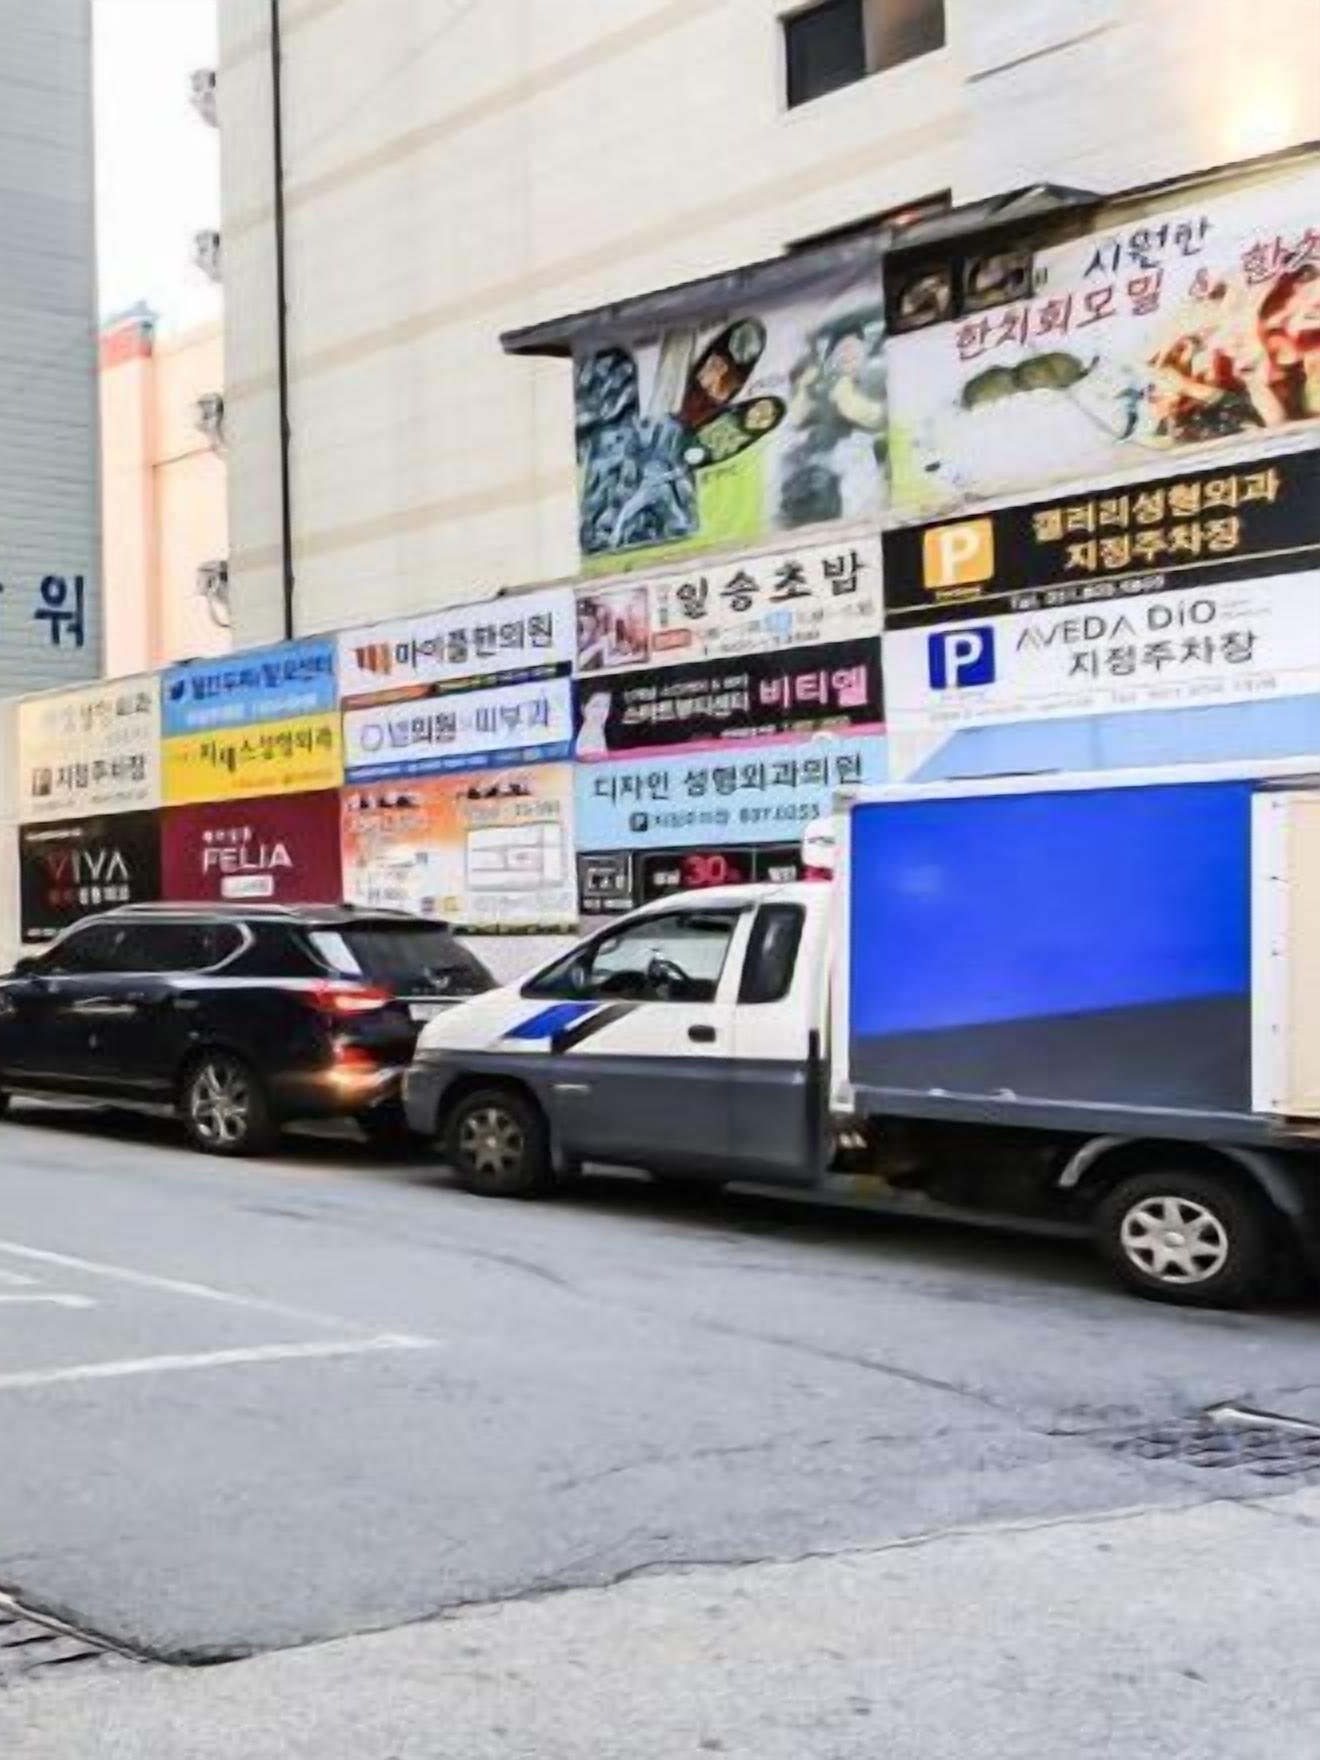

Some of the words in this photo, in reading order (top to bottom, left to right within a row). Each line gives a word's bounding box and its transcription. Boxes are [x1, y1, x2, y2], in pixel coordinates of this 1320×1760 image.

[938, 526, 980, 584] P
[1062, 515, 1242, 572] 지정주차장
[943, 631, 984, 690] P
[1067, 629, 1260, 680] 지정주차장
[594, 768, 669, 805] 디자인
[683, 751, 864, 797] 성형외과의원
[202, 843, 294, 875] FELIA
